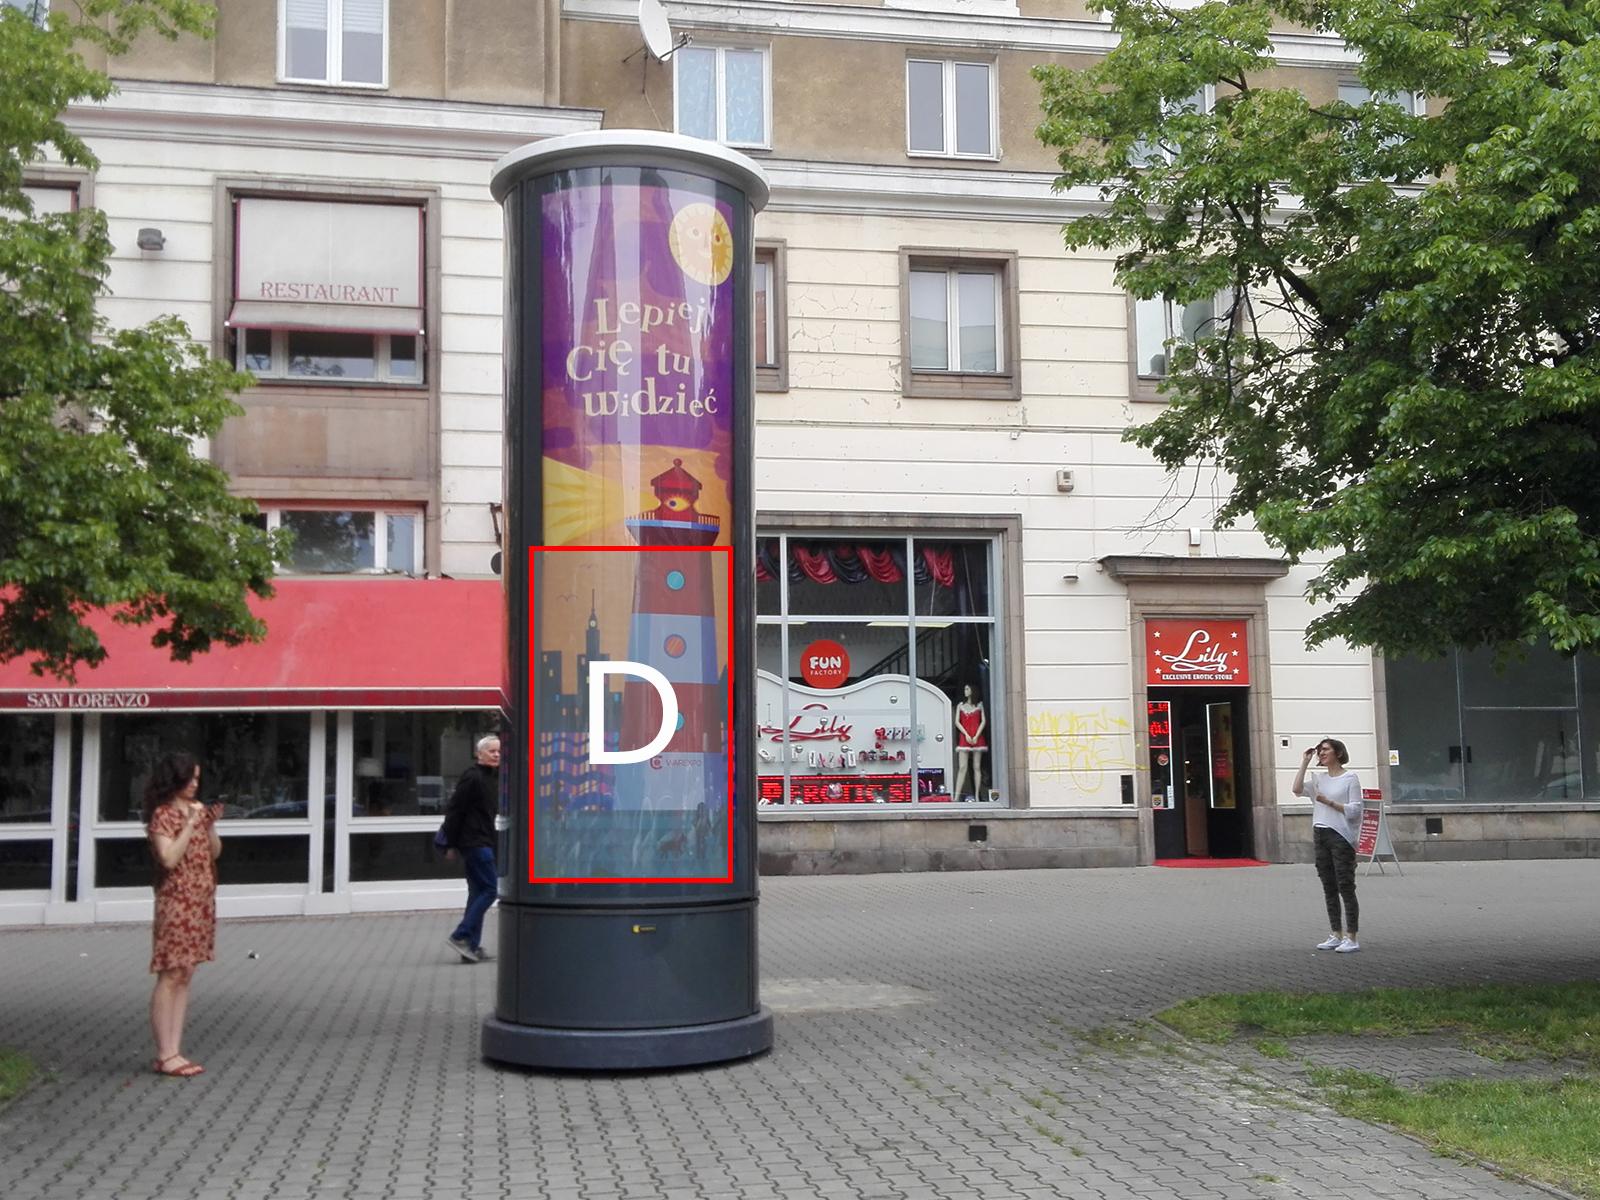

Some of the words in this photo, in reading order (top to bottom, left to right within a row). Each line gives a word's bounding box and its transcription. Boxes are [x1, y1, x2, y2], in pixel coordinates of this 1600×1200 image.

[260, 281, 399, 302] RESTAURANT
[593, 297, 706, 334] Lepiej
[566, 339, 633, 381] Cię
[656, 343, 691, 375] tu
[582, 377, 718, 417] widzieć
[809, 656, 842, 669] FUN
[1161, 629, 1228, 672] Lily
[26, 692, 63, 708] SAN
[68, 692, 150, 708] LORENZO
